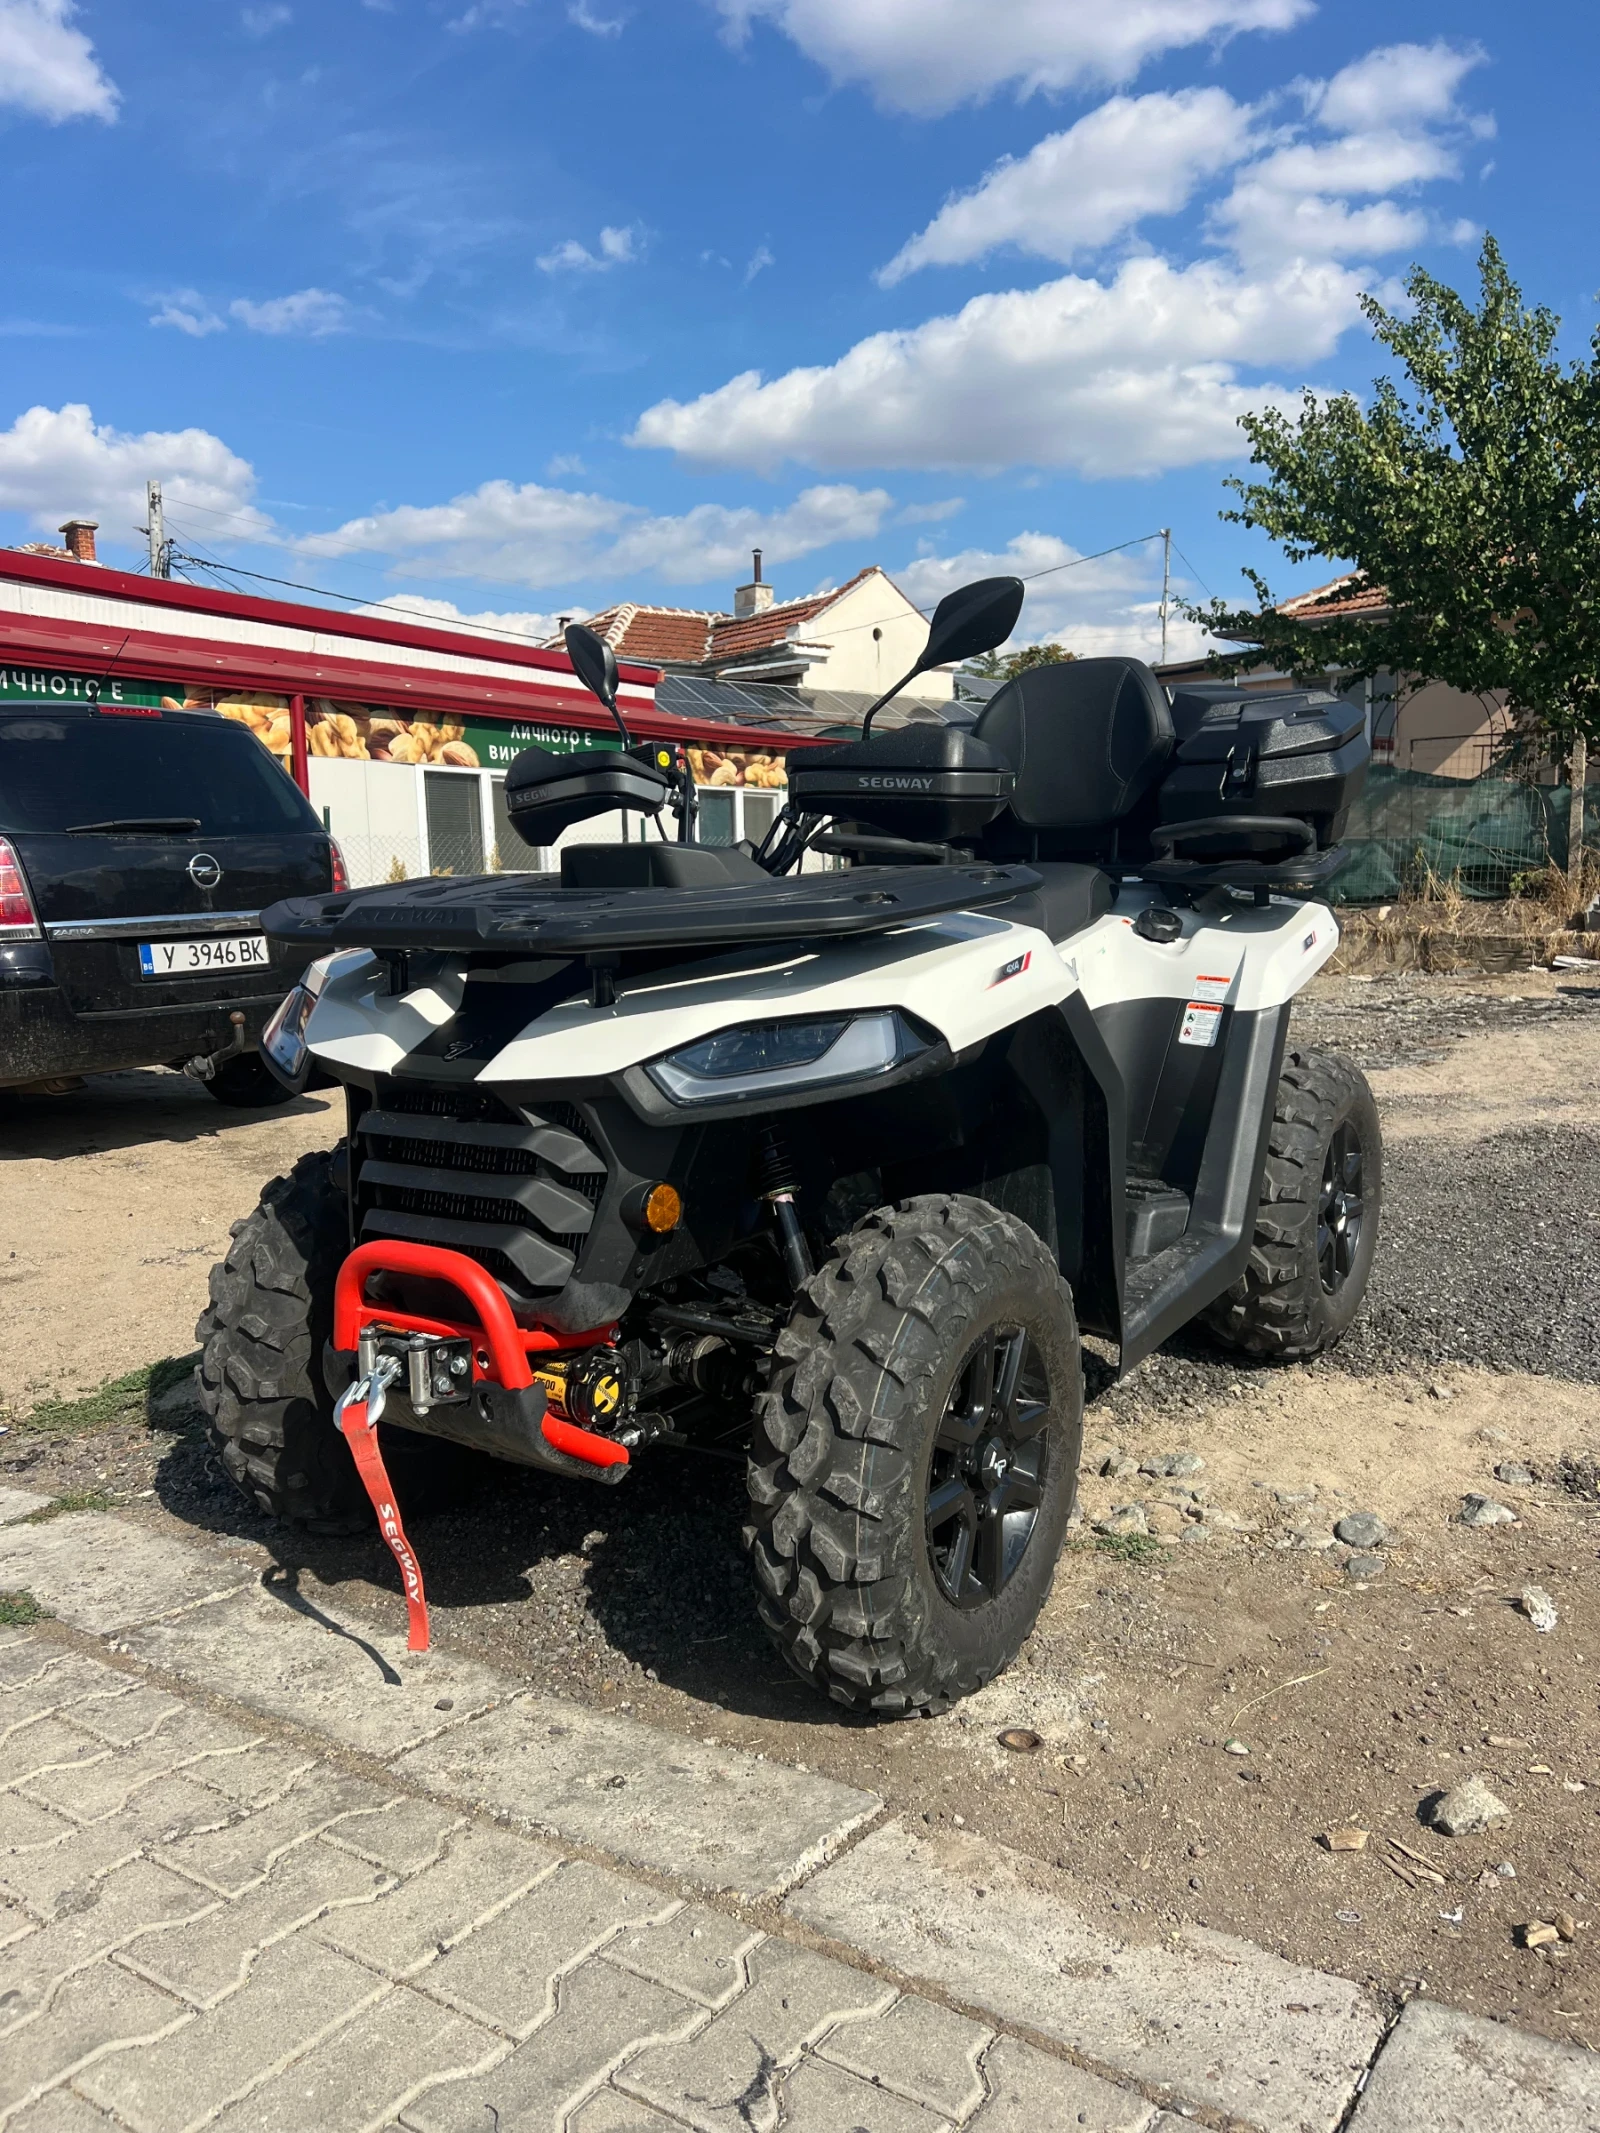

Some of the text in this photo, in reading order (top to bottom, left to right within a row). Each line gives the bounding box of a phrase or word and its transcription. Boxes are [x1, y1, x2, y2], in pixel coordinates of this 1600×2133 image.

[510, 724, 592, 746] ЛИЧНОТО Е
[489, 745, 527, 761] ВИН
[858, 777, 933, 790] SEGWAY
[516, 788, 548, 804] SEGW
[188, 942, 236, 966] 3946
[239, 938, 264, 962] BK
[143, 963, 153, 971] BG
[380, 1503, 420, 1603] SEGWAY
